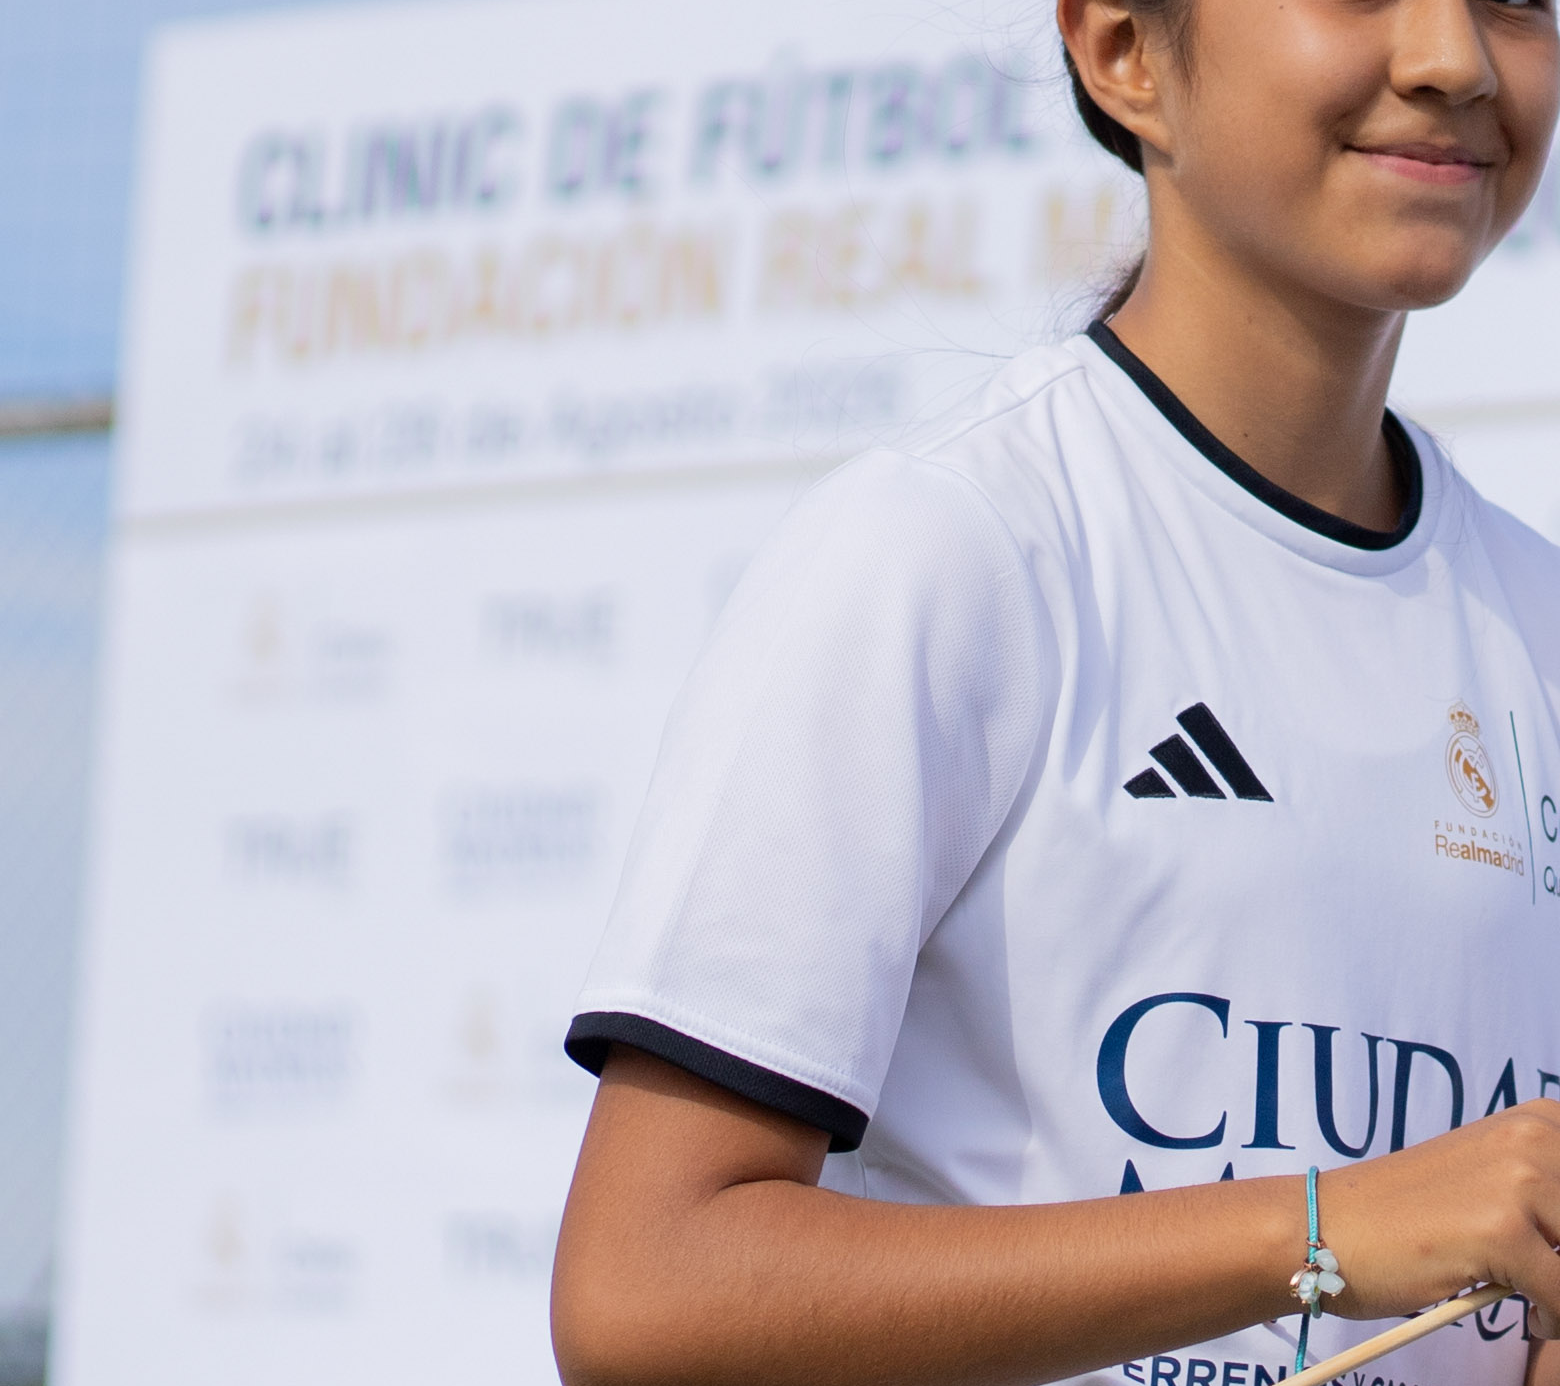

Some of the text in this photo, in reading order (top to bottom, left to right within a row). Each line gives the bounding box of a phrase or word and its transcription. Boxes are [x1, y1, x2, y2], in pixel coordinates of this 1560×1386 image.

[235, 101, 523, 235] CLINIC
[548, 83, 664, 204] DE
[1433, 819, 1524, 853] FUNDACIÓN
[1435, 833, 1525, 877] Realmadrid
